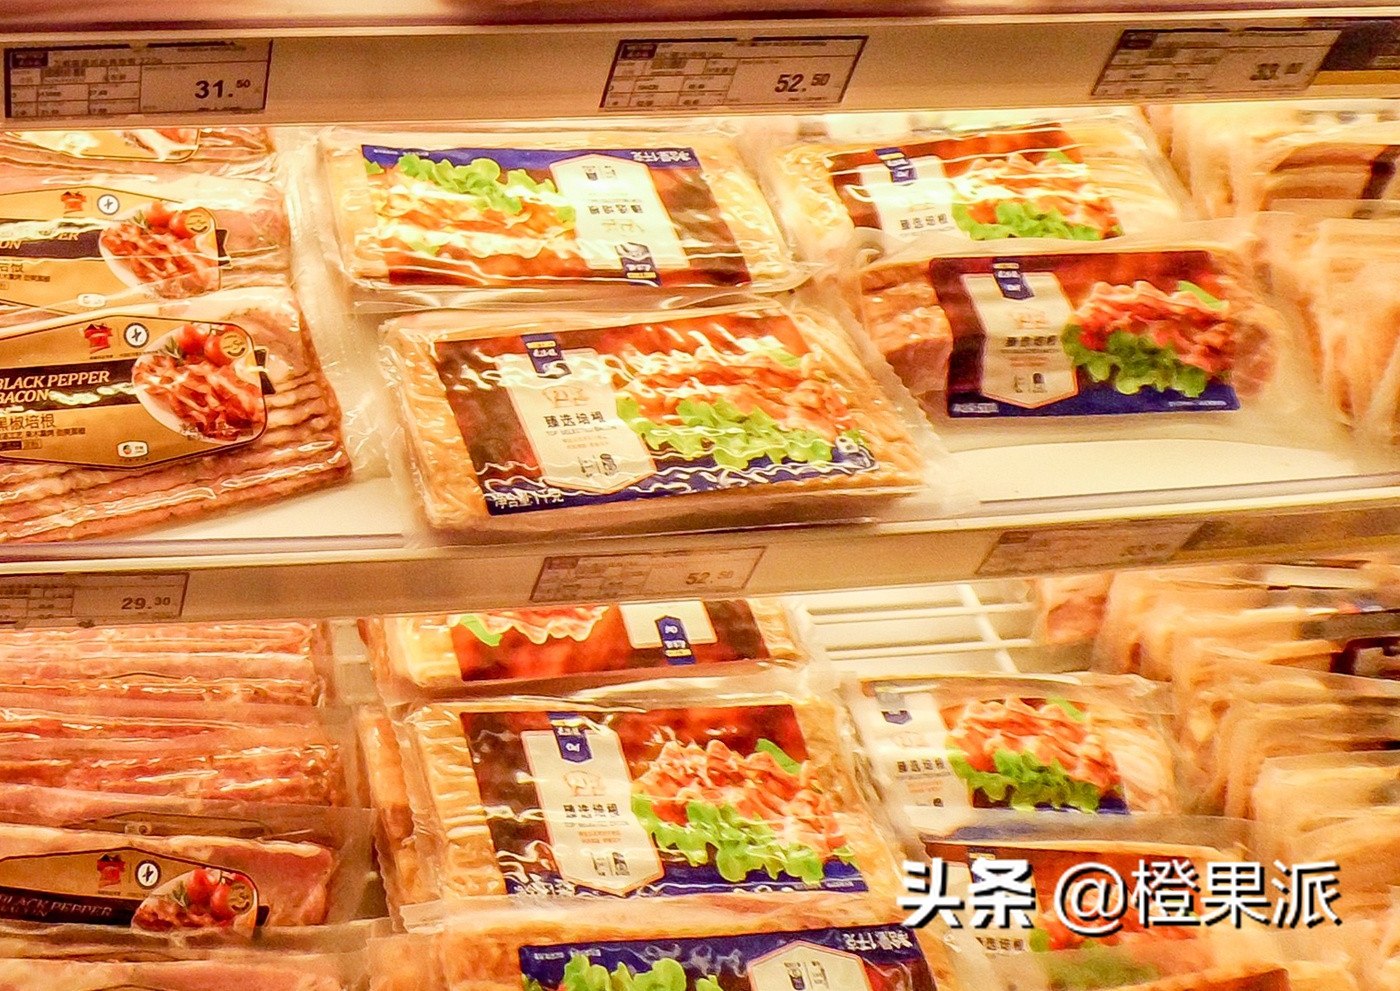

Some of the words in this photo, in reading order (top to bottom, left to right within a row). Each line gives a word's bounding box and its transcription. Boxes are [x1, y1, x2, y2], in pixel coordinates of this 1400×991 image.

[194, 78, 251, 100] 31.50
[774, 72, 831, 94] 52.50
[47, 370, 111, 387] PEPPER
